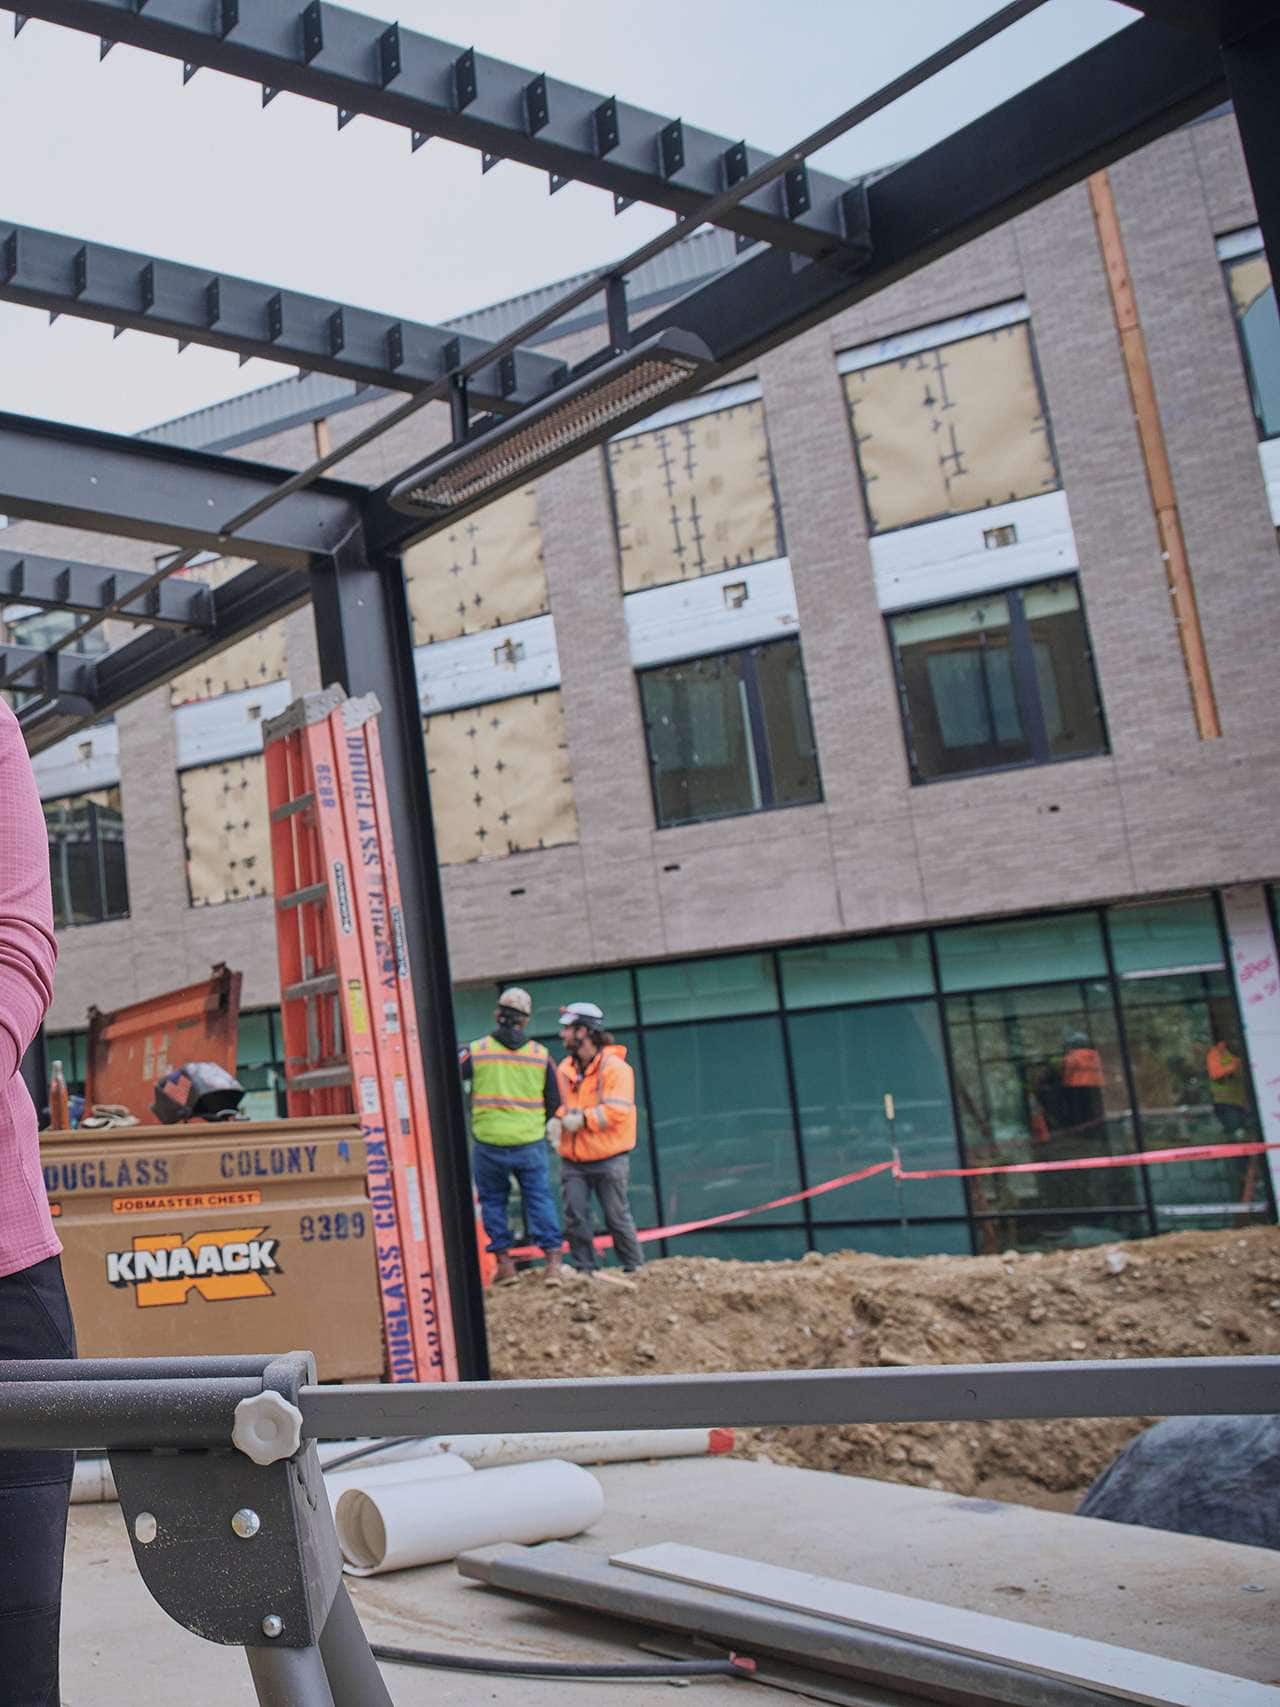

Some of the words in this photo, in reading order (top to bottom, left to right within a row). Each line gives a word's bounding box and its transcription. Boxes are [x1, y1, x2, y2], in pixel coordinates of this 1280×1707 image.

[43, 1158, 169, 1191] OUGLASS
[220, 1145, 318, 1178] COLONY
[360, 1126, 396, 1229] COLONY
[116, 1197, 203, 1211] JOBMASTER
[208, 1193, 254, 1204] CHEST
[107, 1238, 279, 1285] KNAACK
